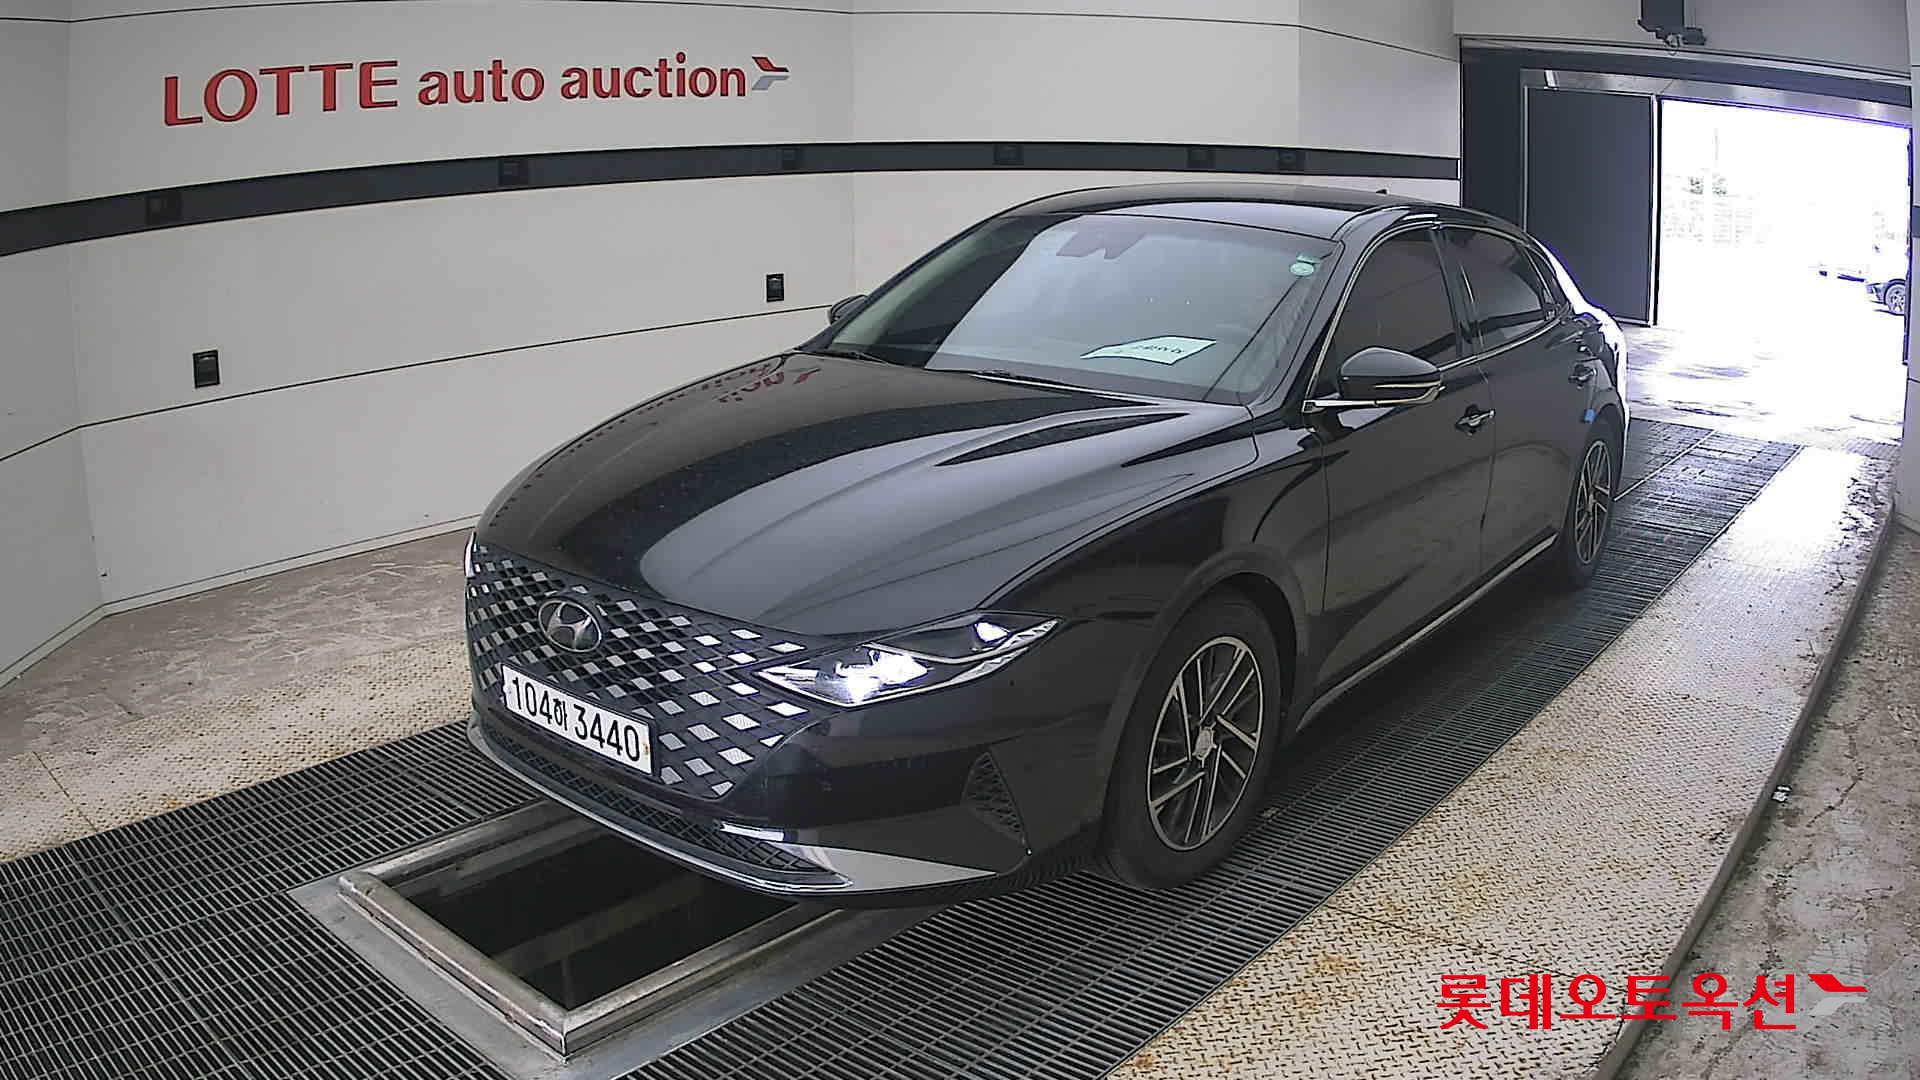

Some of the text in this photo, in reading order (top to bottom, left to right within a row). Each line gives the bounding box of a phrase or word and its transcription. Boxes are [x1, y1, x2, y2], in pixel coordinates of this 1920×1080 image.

[163, 51, 748, 127] LOTTE auto auction
[512, 676, 641, 762] 104하 3440
